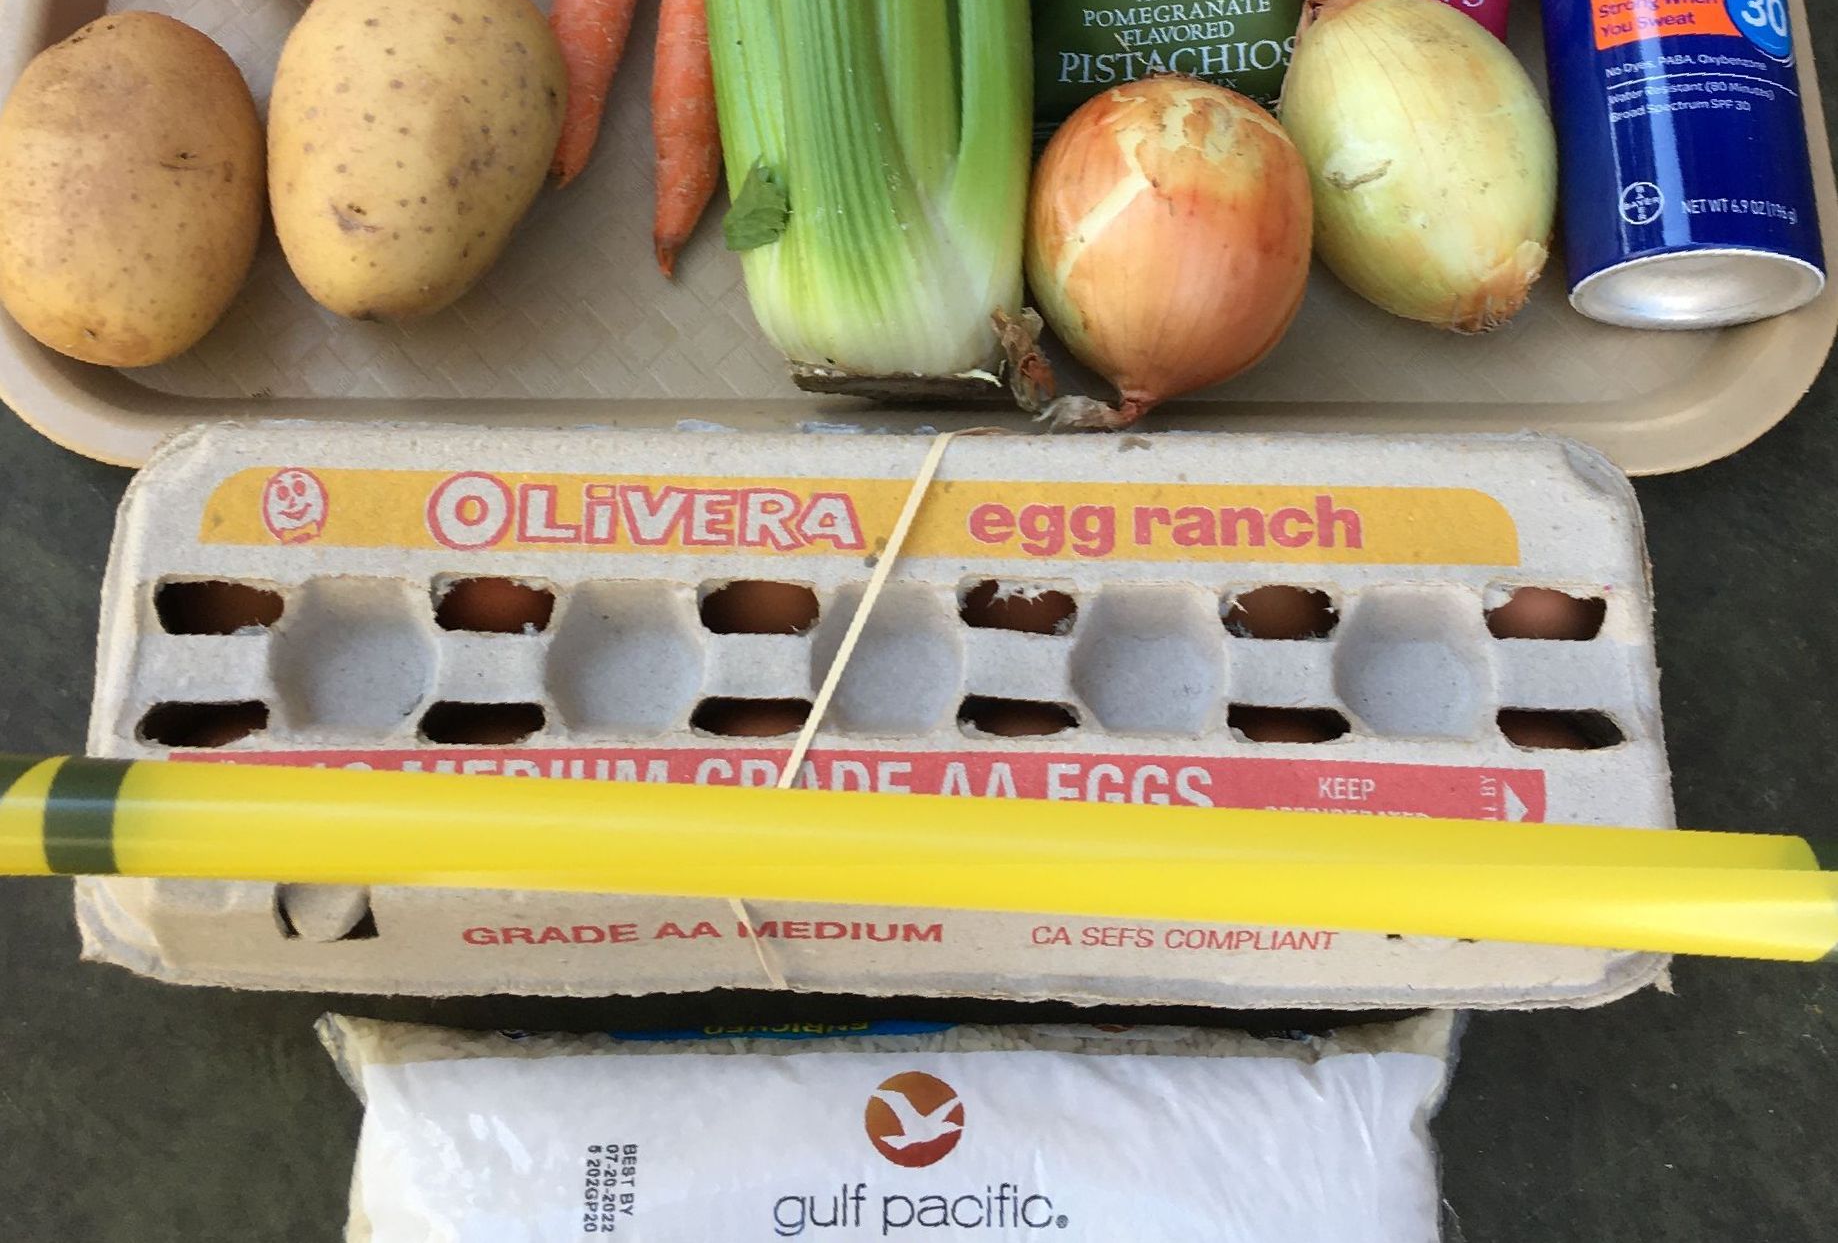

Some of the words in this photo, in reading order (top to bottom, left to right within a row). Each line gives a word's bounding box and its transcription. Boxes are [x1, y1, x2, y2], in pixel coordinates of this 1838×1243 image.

[1122, 21, 1235, 47] FLAVORED
[1600, 19, 1633, 38] You
[1637, 11, 1697, 29] Sweat
[1605, 66, 1622, 78] No
[1611, 106, 1646, 123] Broad
[1710, 98, 1734, 109] SPF
[1682, 198, 1706, 215] NET
[968, 499, 1118, 557] egg
[1133, 493, 1364, 551] ranch
[940, 761, 1019, 799] AA
[1047, 763, 1216, 808] EGGS
[1318, 776, 1377, 801] KEEP
[1480, 775, 1497, 798] BY
[461, 923, 640, 946] GRADE
[651, 921, 723, 941] AA
[737, 921, 945, 944] MEDIUM
[1031, 926, 1073, 946] CA
[1080, 926, 1155, 949] SEFS
[1164, 929, 1340, 951] COMPLIANT
[621, 1144, 638, 1188] BEST
[583, 1158, 601, 1233] 202GP20
[601, 1144, 619, 1233] 07-20-2022
[619, 1193, 635, 1217] BY
[773, 1183, 868, 1237] gulf
